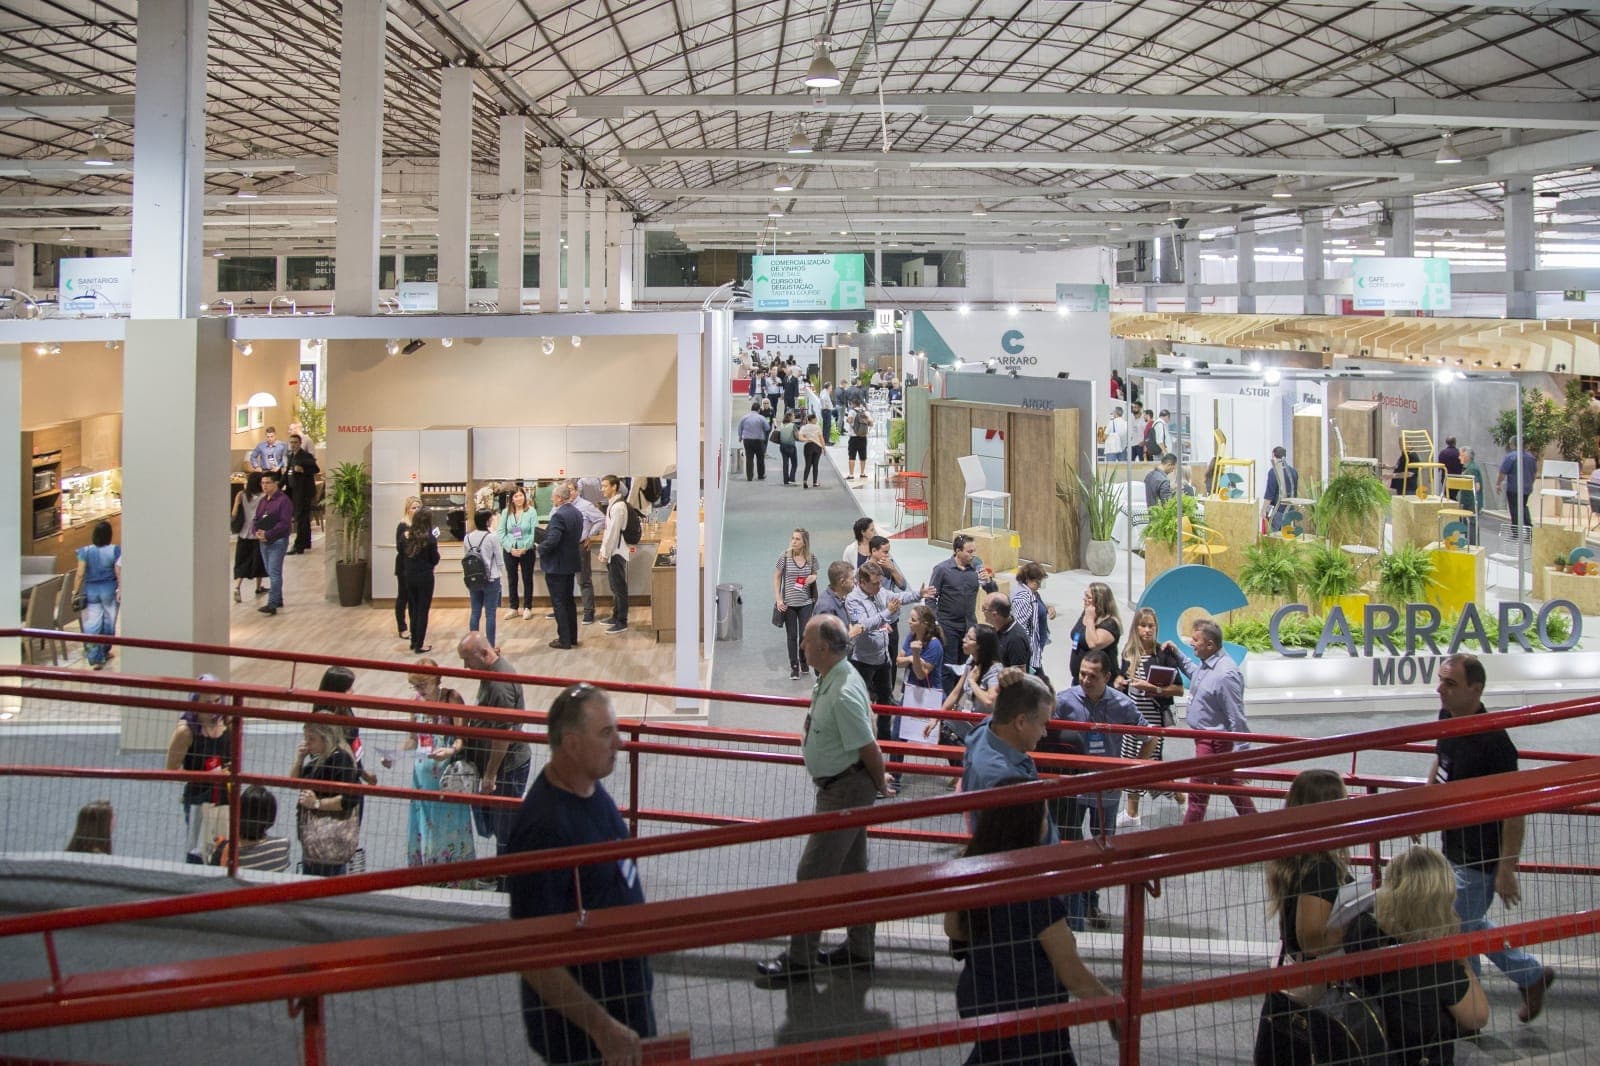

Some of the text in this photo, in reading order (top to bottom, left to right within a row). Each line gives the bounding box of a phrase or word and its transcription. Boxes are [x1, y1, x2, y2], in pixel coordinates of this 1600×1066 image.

[771, 259, 830, 267] COMERCIALIZAÇÃO
[772, 283, 814, 291] DEGUSTAÇÃO
[765, 334, 825, 344] BLUME
[990, 355, 1038, 366] ARRARO
[1239, 387, 1270, 397] ASTOR
[337, 425, 373, 433] MADESA
[1269, 600, 1584, 658] CARRARO
